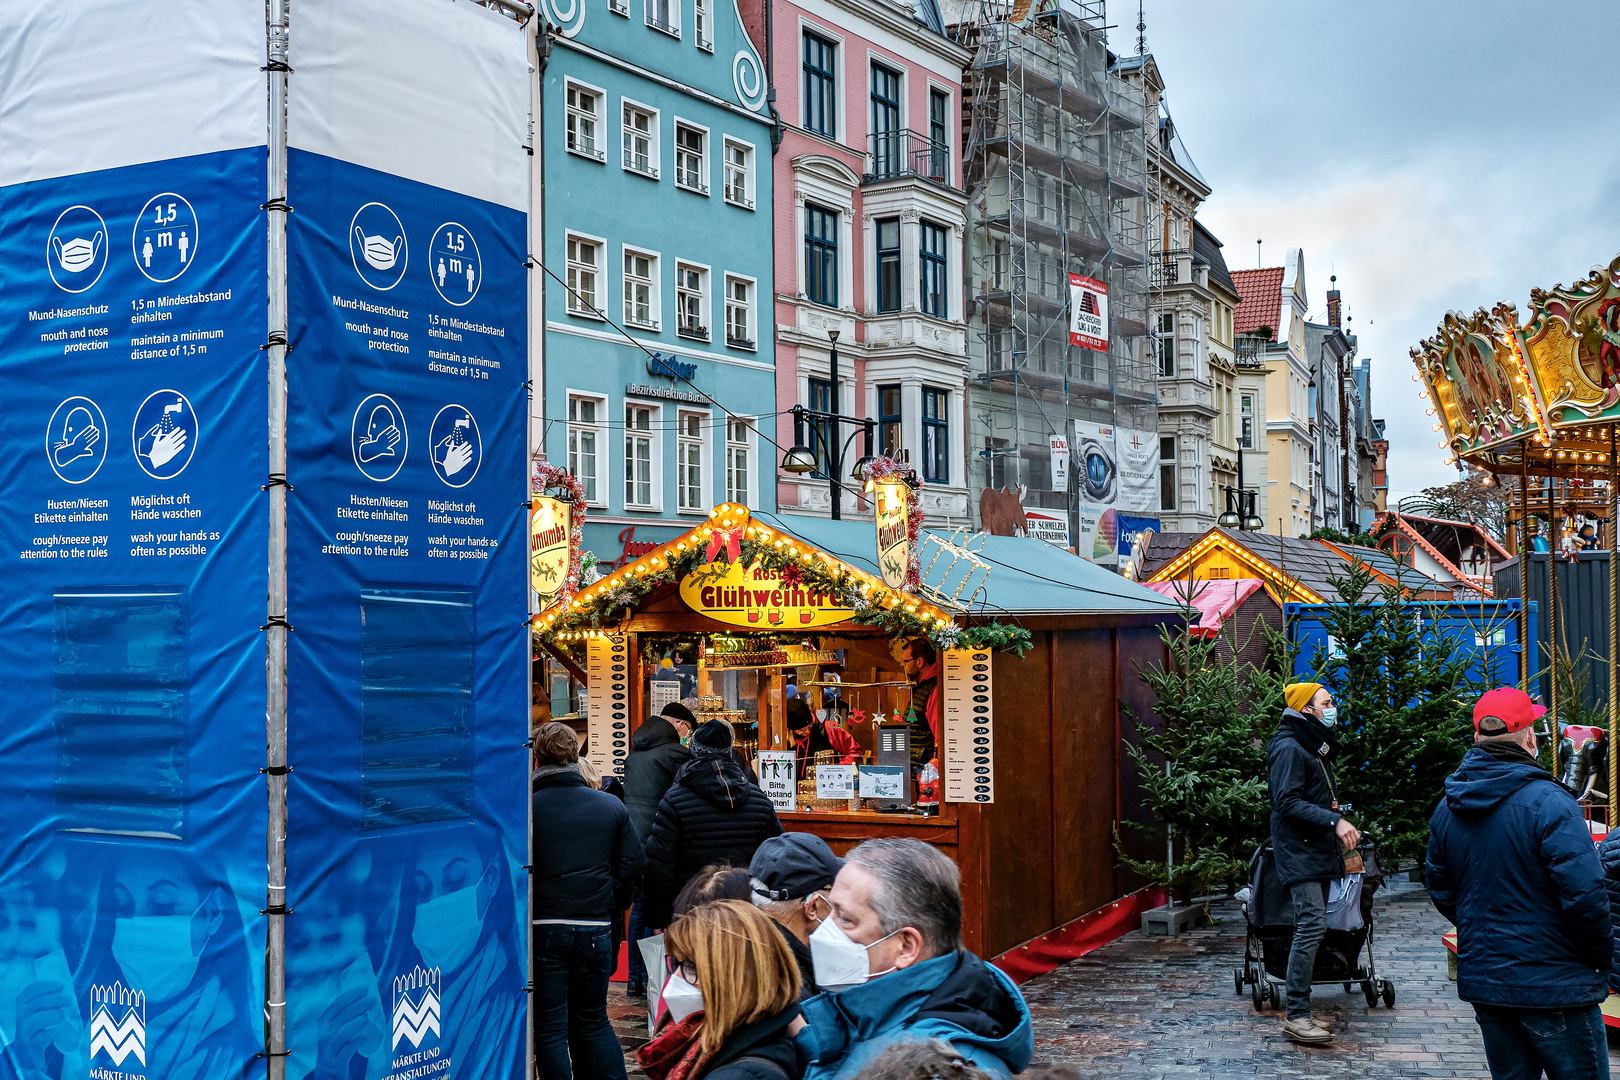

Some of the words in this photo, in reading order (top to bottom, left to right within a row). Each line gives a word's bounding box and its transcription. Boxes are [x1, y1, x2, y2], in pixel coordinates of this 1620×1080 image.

[155, 203, 176, 226] 1,5
[158, 232, 172, 247] m
[447, 232, 464, 253] 1,5
[450, 259, 461, 273] m
[132, 299, 144, 311] 1,5
[158, 289, 231, 307] Mindestabstand
[29, 305, 108, 320] Mund-Nasenschutz
[333, 296, 408, 319] Mund-Nasenschutz
[131, 310, 172, 323] einhalten
[346, 323, 370, 334] mouth
[373, 327, 388, 337] and
[391, 331, 408, 340] nose
[429, 314, 439, 325] 1,5
[449, 318, 504, 337] Mindestabstand
[41, 329, 67, 341] mouth
[70, 327, 85, 338] and
[88, 328, 108, 336] nose
[131, 333, 170, 346] maintain
[181, 330, 223, 341] minimum
[429, 327, 463, 341] einhalten
[65, 340, 108, 355] protection
[131, 349, 167, 360] distance
[170, 346, 179, 356] of
[183, 344, 195, 356] 1,5
[369, 338, 409, 353] protection
[429, 350, 460, 363] maintain
[469, 356, 500, 370] minimum
[429, 362, 458, 374] distance
[460, 367, 468, 376] of
[470, 368, 479, 378] 1,5
[630, 382, 687, 400] Bezirksdirektion
[48, 498, 108, 509] Husten/Niesen
[131, 495, 174, 508] Möglichst
[177, 493, 190, 504] oft
[350, 494, 408, 508] Husten/Niesen
[428, 500, 463, 513] Möglichst
[465, 503, 475, 512] oft
[35, 513, 66, 523] Etikette
[69, 511, 108, 522] einhalten
[131, 509, 159, 520] Hände
[162, 507, 201, 518] waschen
[338, 508, 369, 519] Etikette
[371, 510, 408, 521] einhalten
[428, 512, 451, 523] Hände
[454, 516, 483, 525] waschen
[1038, 521, 1067, 531] SCHMELZER
[33, 535, 90, 547] cough/sneeze
[93, 536, 108, 546] pay
[131, 532, 154, 542] wash
[157, 534, 177, 544] your
[180, 530, 207, 541] hands
[210, 532, 219, 540] as
[336, 531, 392, 543] cough/sneeze
[394, 536, 408, 545] pay
[428, 535, 447, 544] wash
[450, 538, 466, 547] your
[468, 536, 488, 546] hands
[21, 548, 57, 558] attention
[60, 549, 69, 558] to
[71, 548, 85, 557] the
[87, 547, 107, 557] rules
[131, 546, 154, 556] often
[169, 544, 206, 558] possible
[322, 544, 361, 554] attention
[364, 546, 372, 555] to
[375, 546, 387, 556] the
[390, 546, 408, 556] rules
[428, 548, 447, 557] often
[460, 549, 487, 560] possible
[769, 781, 786, 789] Bitte
[763, 790, 792, 799] Abstand
[391, 1052, 422, 1070] MÄRKTE
[423, 1046, 440, 1061] UND
[89, 1067, 123, 1080] MÄRKTE
[381, 1057, 452, 1080] ERANSTALTUNGEN
